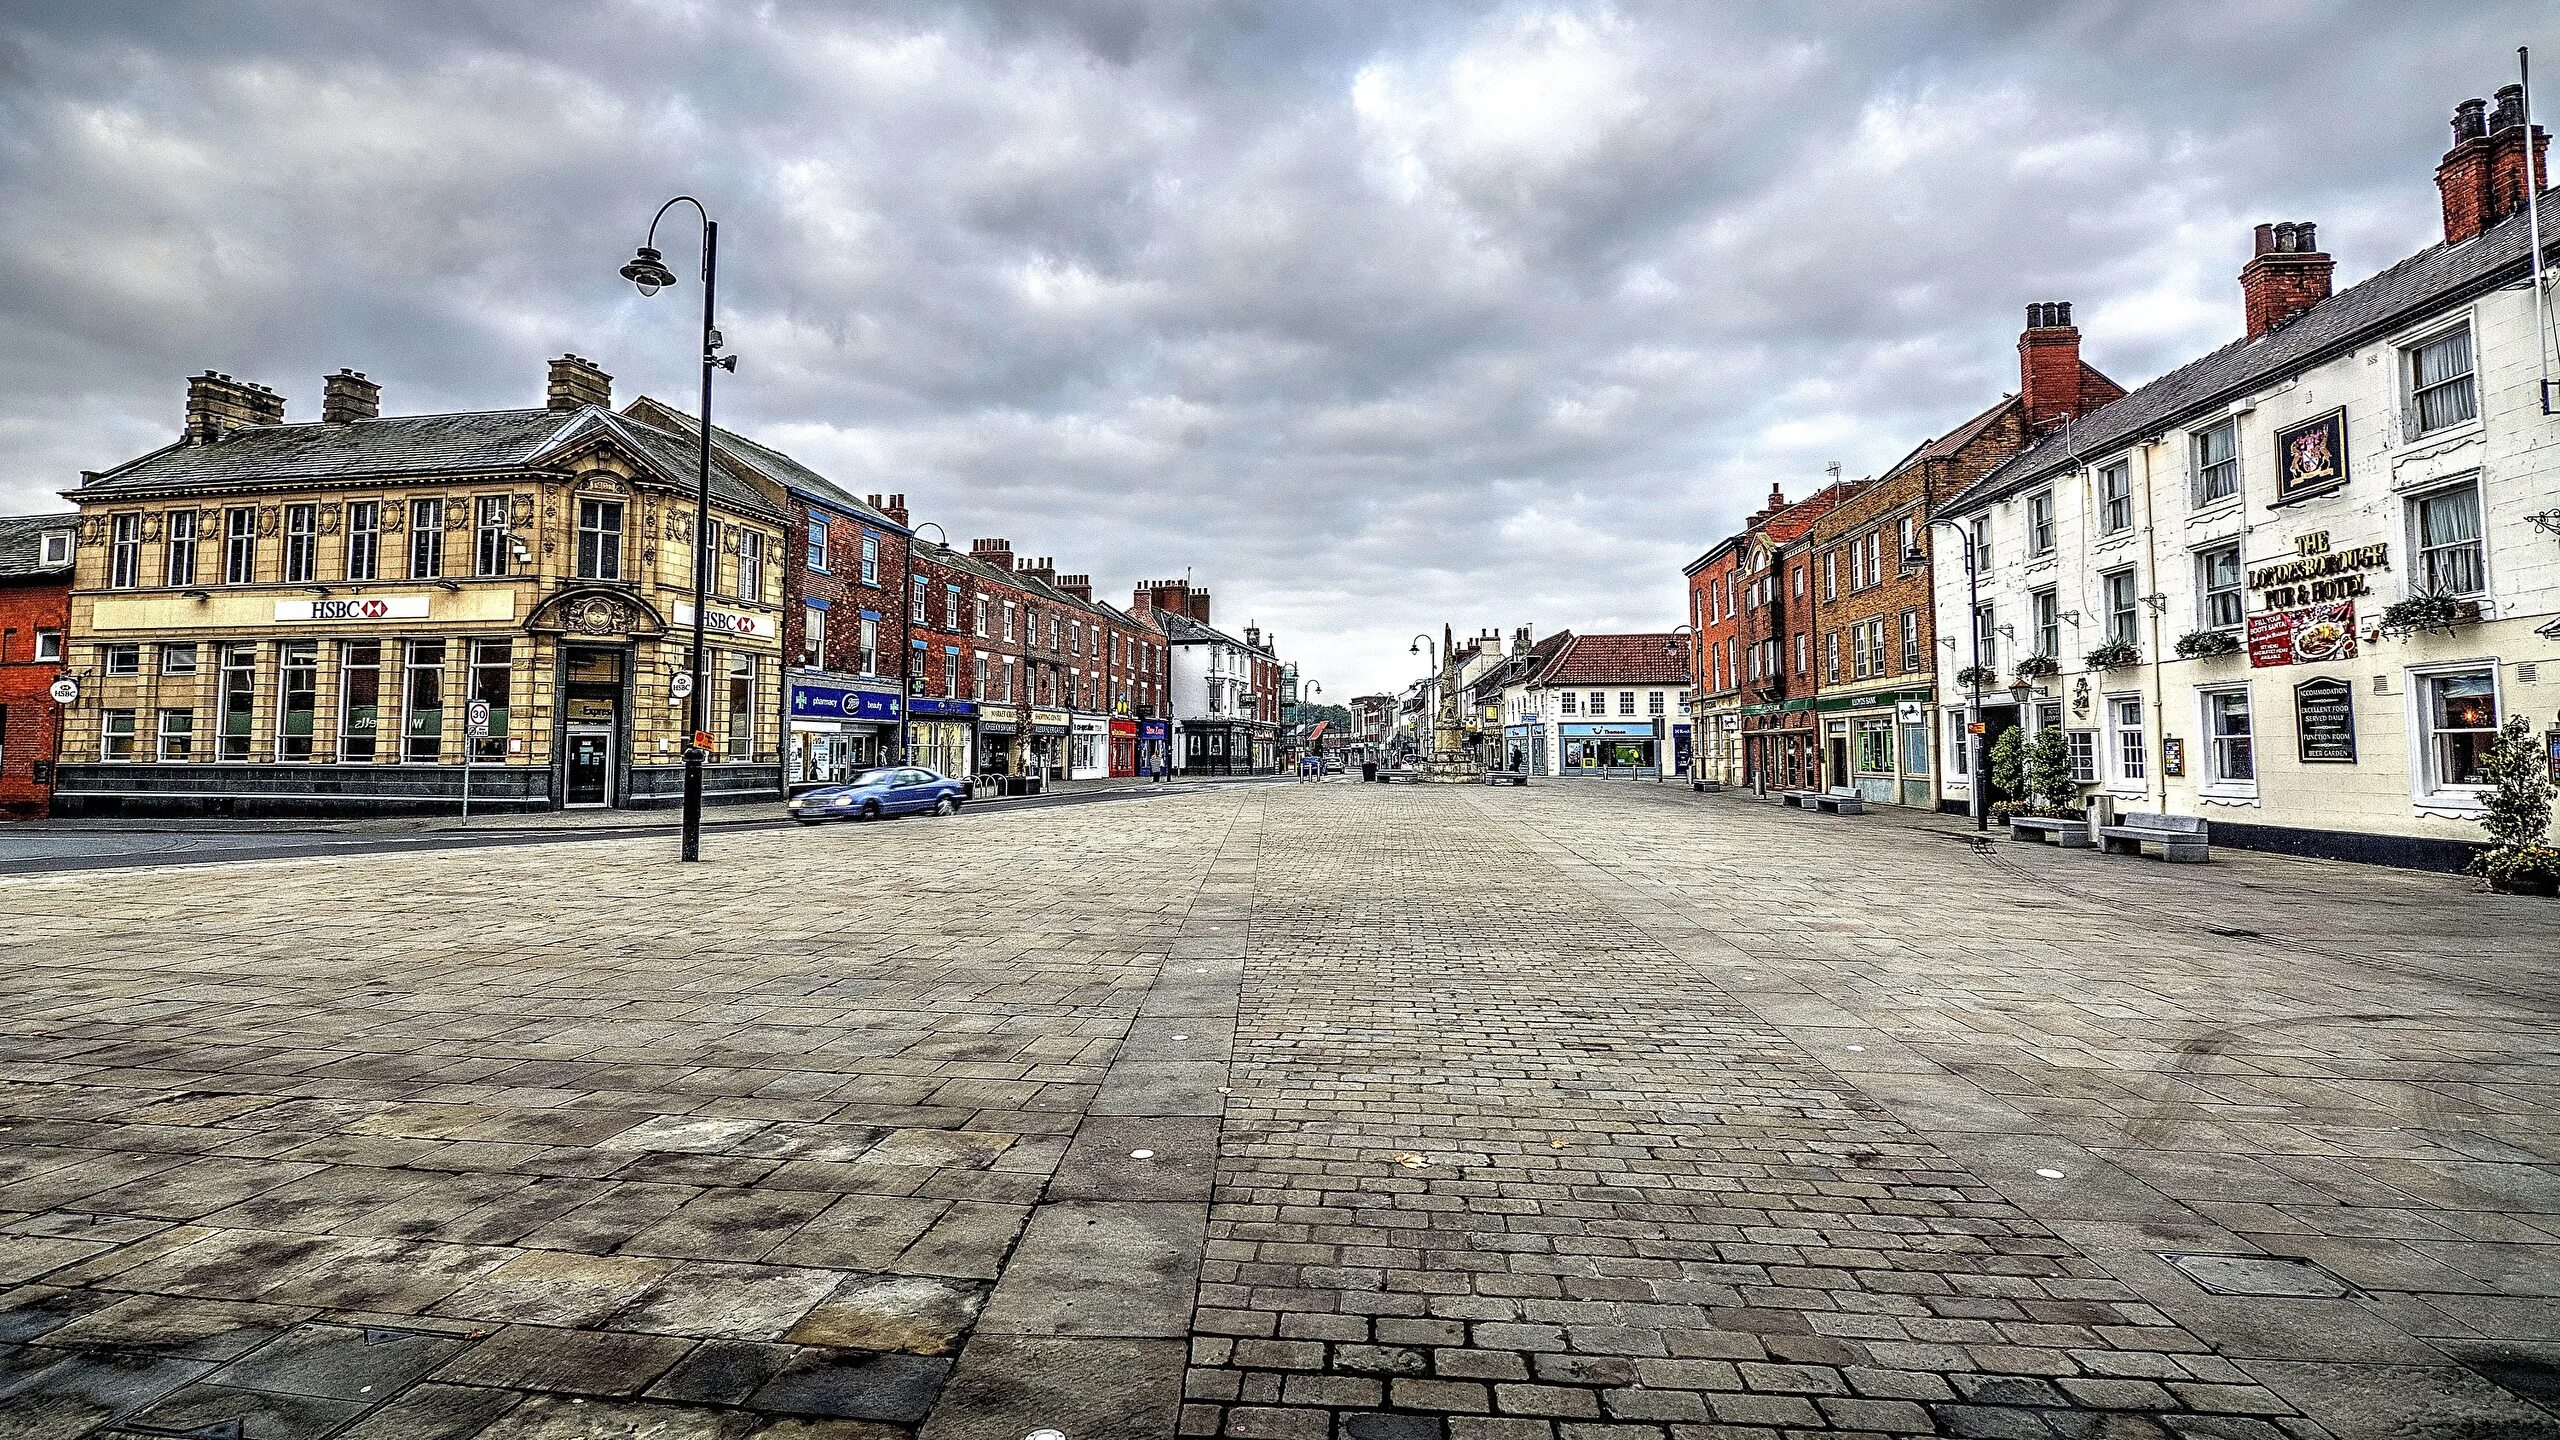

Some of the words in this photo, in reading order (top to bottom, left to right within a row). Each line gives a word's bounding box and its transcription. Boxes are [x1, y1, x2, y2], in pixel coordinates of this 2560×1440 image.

[2295, 530, 2330, 557] THE
[2248, 542, 2389, 589] LONDESBOROUGH
[2264, 586, 2295, 611] PUB
[2297, 584, 2311, 606] &
[2311, 573, 2370, 603] HOTEL
[311, 601, 361, 619] HSBC
[702, 610, 736, 630] HSBC
[2266, 614, 2281, 623] YOUR
[54, 690, 76, 698] HSBC
[2300, 687, 2347, 697] ACCOMMODATION
[812, 697, 838, 708] pharmacy
[867, 701, 882, 710] beauty
[2301, 706, 2331, 714] EXCELLENT
[2332, 705, 2349, 713] FOOD
[472, 710, 486, 719] 30
